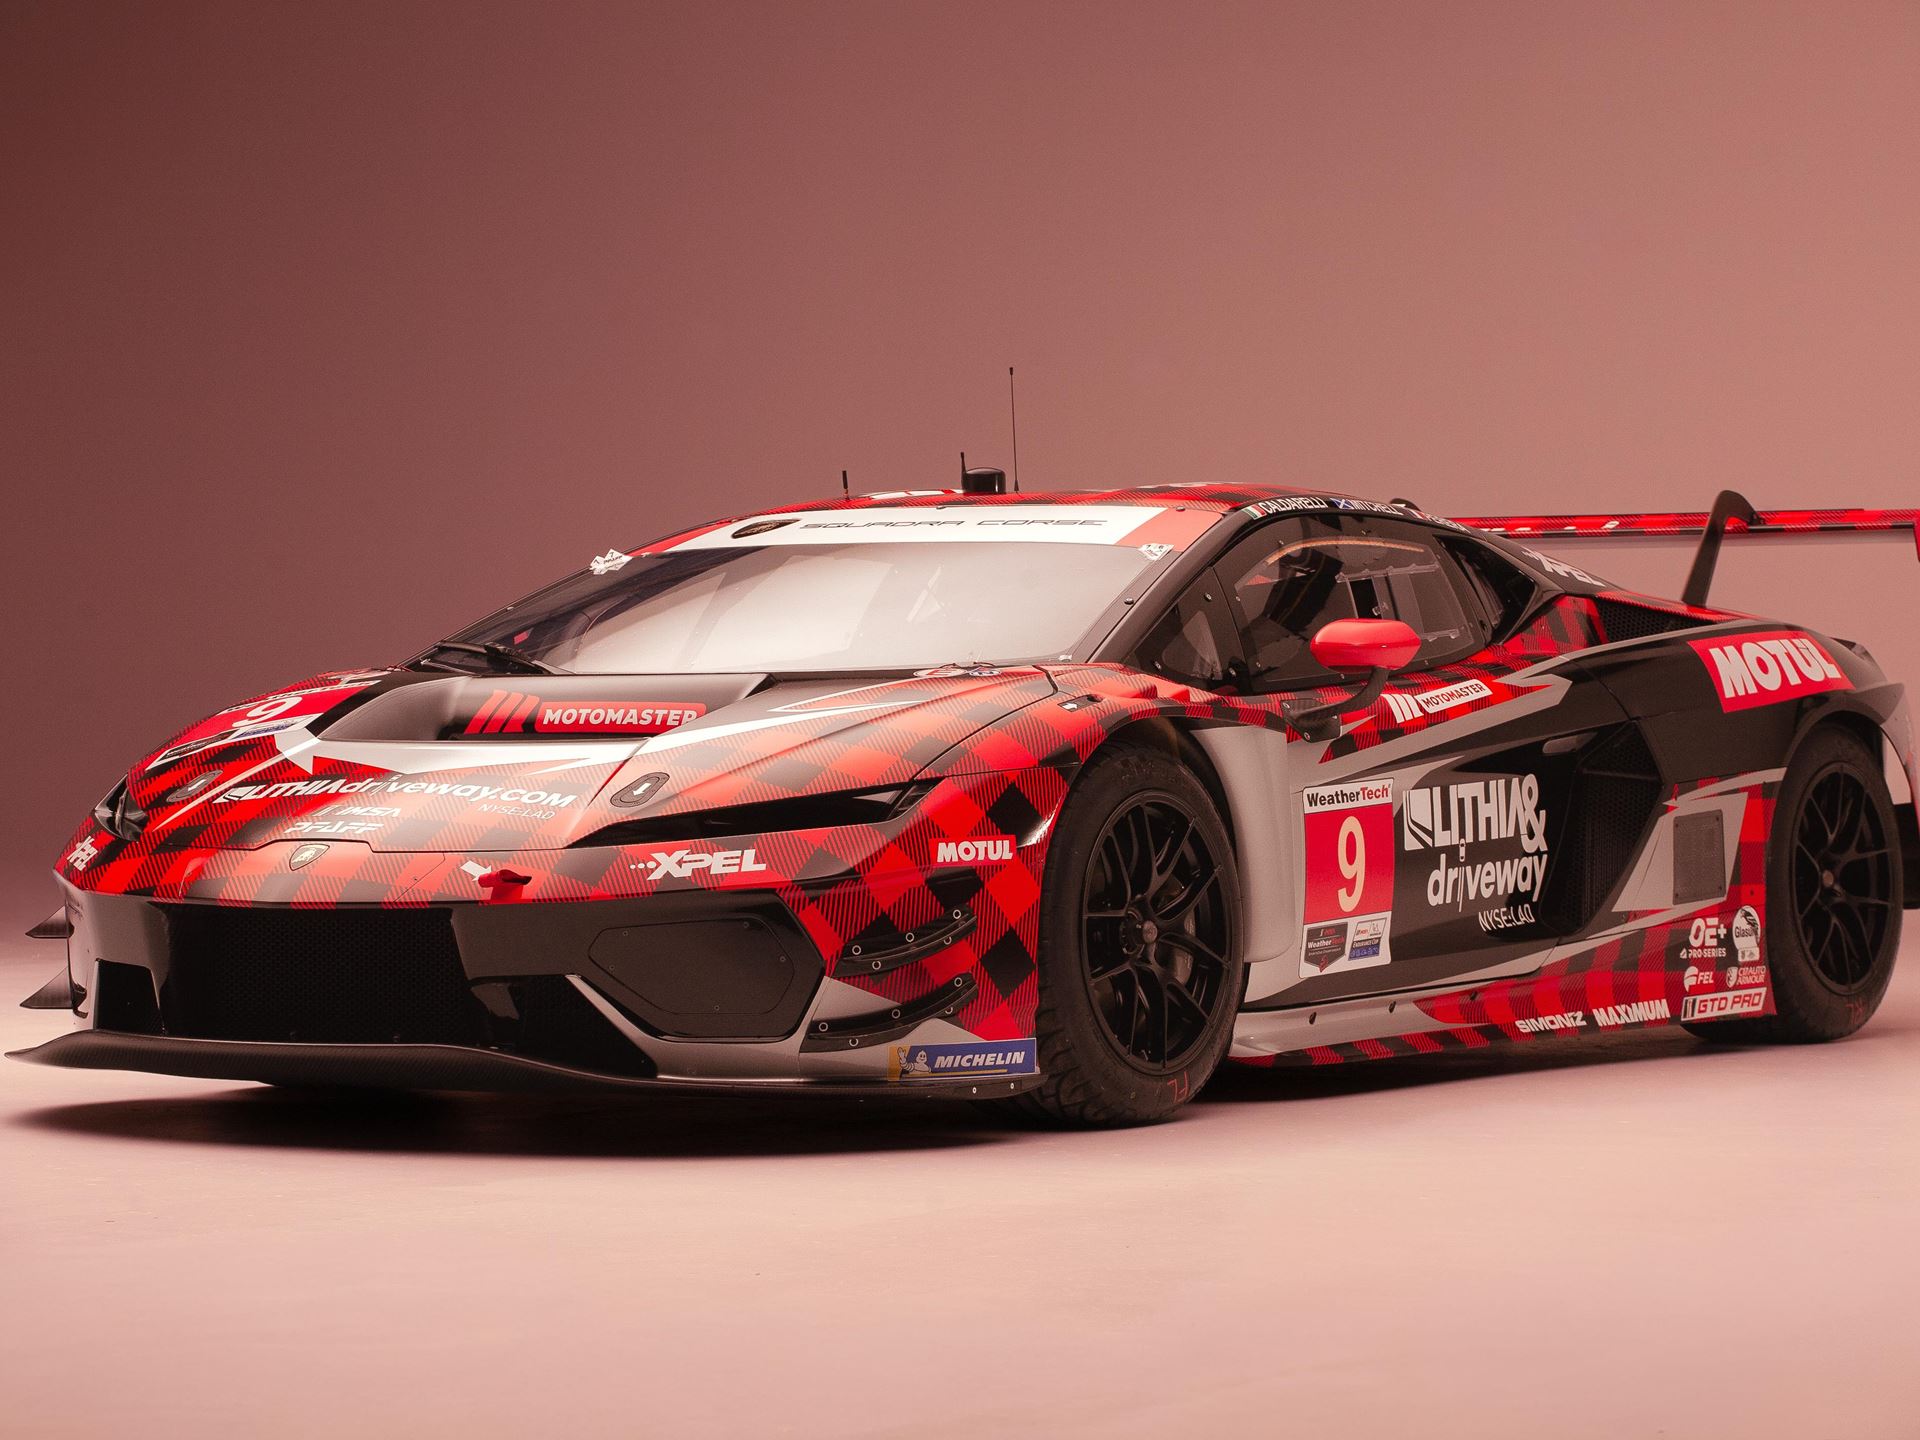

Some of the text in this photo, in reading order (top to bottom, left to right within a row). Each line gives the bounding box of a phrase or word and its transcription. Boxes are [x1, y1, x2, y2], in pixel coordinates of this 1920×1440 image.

[799, 519, 965, 530] SQUADRA
[976, 519, 1108, 527] CORSE
[1708, 638, 1842, 699] MOTUL
[1421, 683, 1486, 709] MOTOMASTER
[231, 696, 303, 728] 9
[1306, 783, 1389, 807] WeatherTech
[647, 848, 767, 881] XPEL
[936, 839, 1014, 864] MOTUL
[1337, 815, 1366, 913] 9
[1427, 853, 1548, 913] driveway
[1688, 917, 1728, 948] OE+
[1697, 971, 1714, 984] FEL
[1592, 999, 1670, 1027] MAXIMUM
[1697, 992, 1763, 1014] GTD PRO
[934, 1051, 1025, 1069] MICHELIN
